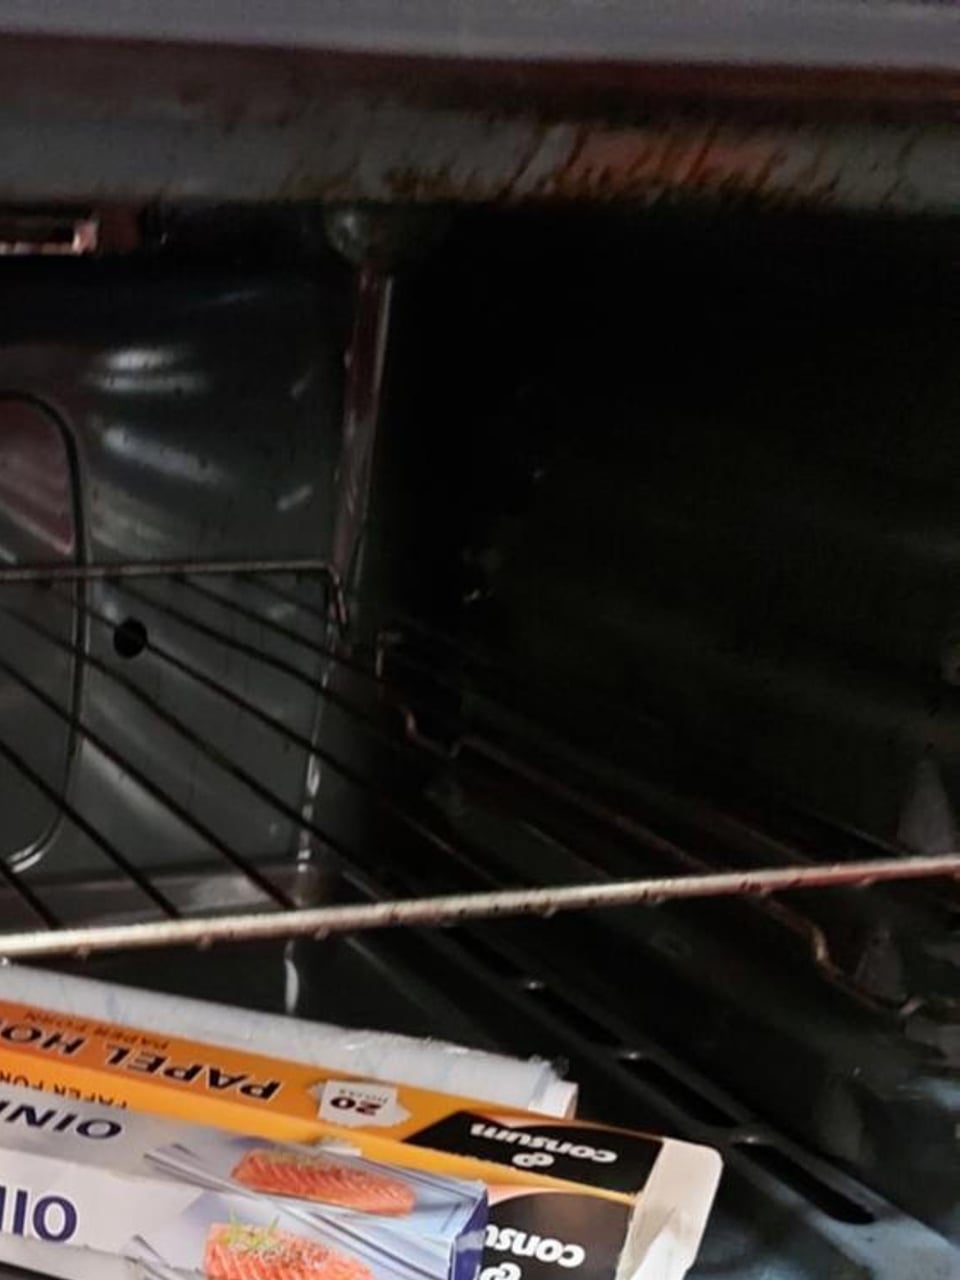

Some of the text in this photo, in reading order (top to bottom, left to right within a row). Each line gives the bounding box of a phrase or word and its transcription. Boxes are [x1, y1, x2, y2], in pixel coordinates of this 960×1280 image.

[105, 1044, 282, 1101] PAPEL
[329, 1094, 382, 1117] 20
[470, 1122, 618, 1164] consum
